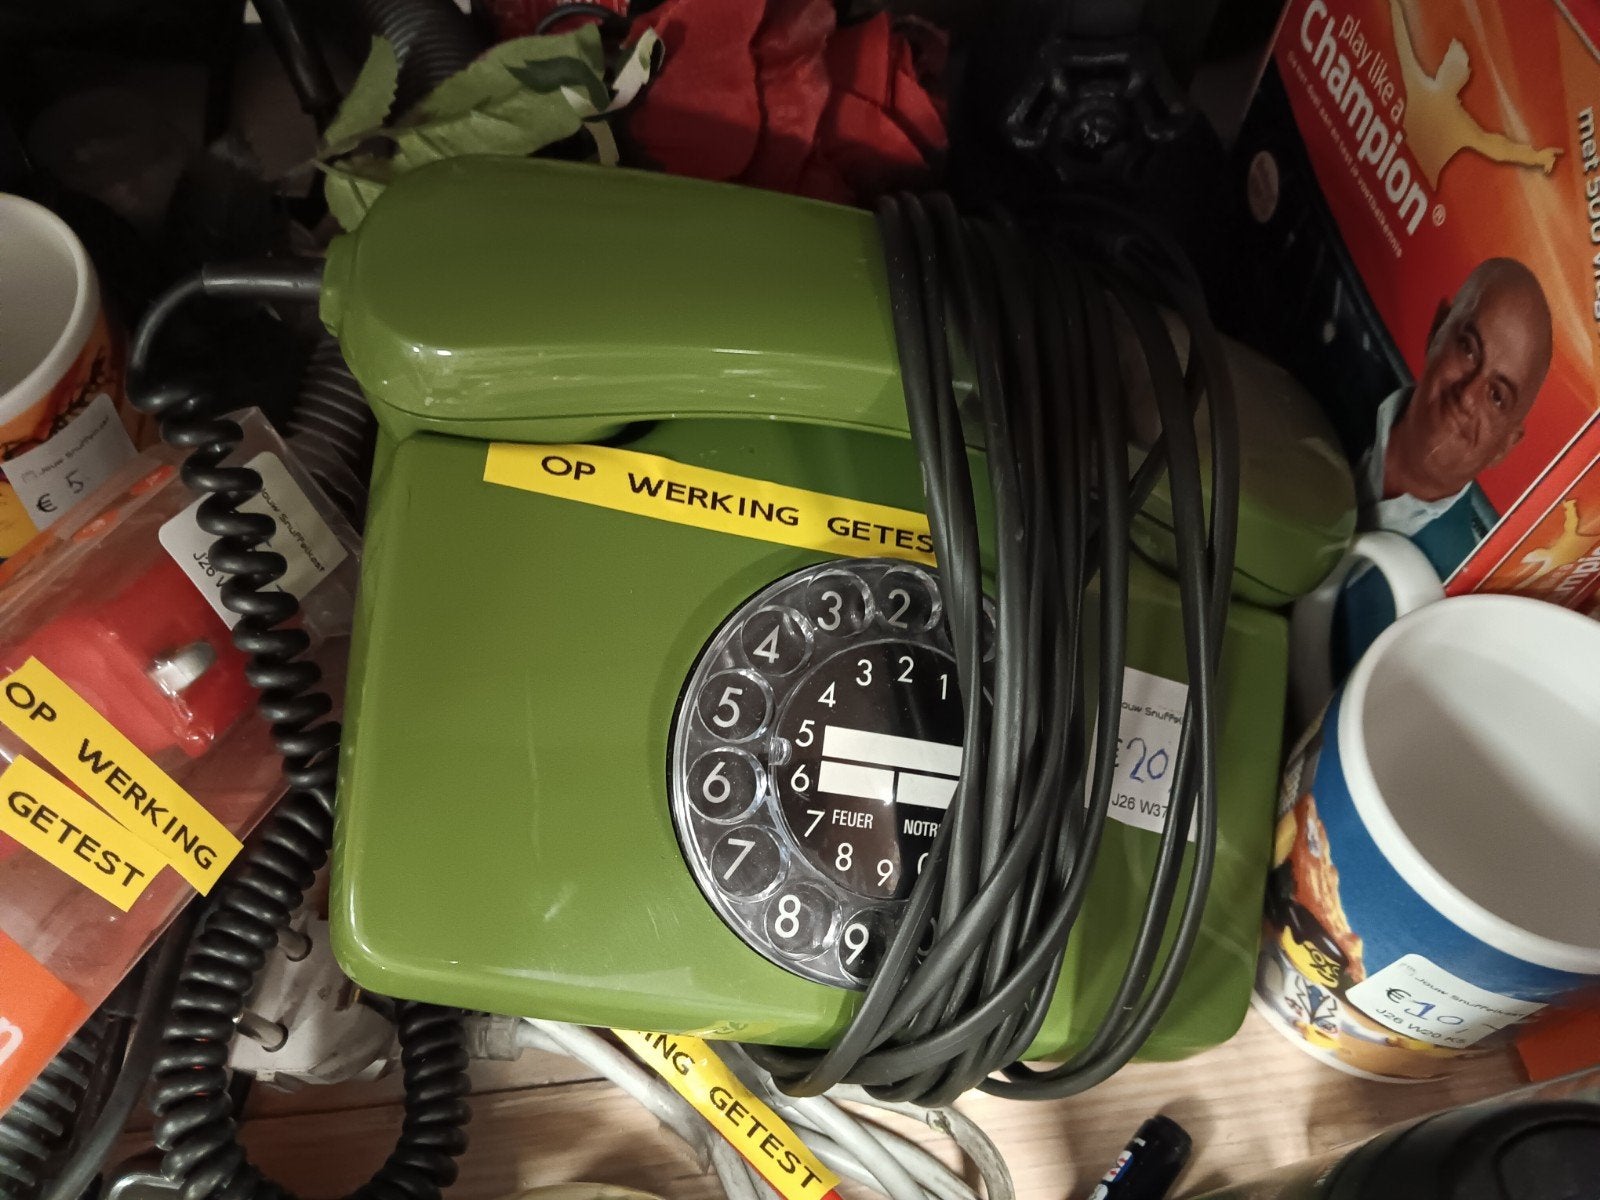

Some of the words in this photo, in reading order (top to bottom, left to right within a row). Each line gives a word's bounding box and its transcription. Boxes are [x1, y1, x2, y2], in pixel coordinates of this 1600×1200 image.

[1338, 14, 1372, 70] play
[1368, 55, 1396, 104] like
[1390, 97, 1405, 125] a
[1300, 1, 1428, 236] Champion
[1577, 106, 1600, 174] met
[260, 486, 281, 514] ouw
[541, 455, 596, 481] OP
[628, 472, 800, 527] WERKING
[827, 516, 934, 553] GETES
[817, 590, 843, 631] 3
[887, 589, 911, 629] 2
[753, 625, 780, 664] 4
[855, 659, 874, 687] 3
[898, 656, 915, 683] 2
[940, 673, 948, 700] 1
[712, 688, 743, 728] 5
[818, 681, 838, 708] 4
[1121, 701, 1143, 713] ouw
[795, 720, 815, 748] 5
[5, 681, 57, 724] OP
[77, 738, 218, 870] WERKING
[703, 761, 732, 804] 6
[790, 765, 810, 793] 6
[831, 809, 874, 830] FEUER
[1112, 793, 1136, 811] J26
[7, 791, 145, 888] GETEST
[803, 810, 825, 838] 7
[903, 818, 941, 838] NOTR
[724, 838, 756, 881] 7
[835, 842, 854, 871] 8
[876, 859, 894, 887] 9
[774, 893, 802, 939] 8
[844, 923, 870, 966] 9
[637, 1030, 696, 1076] ING
[709, 1086, 823, 1188] GETEST
